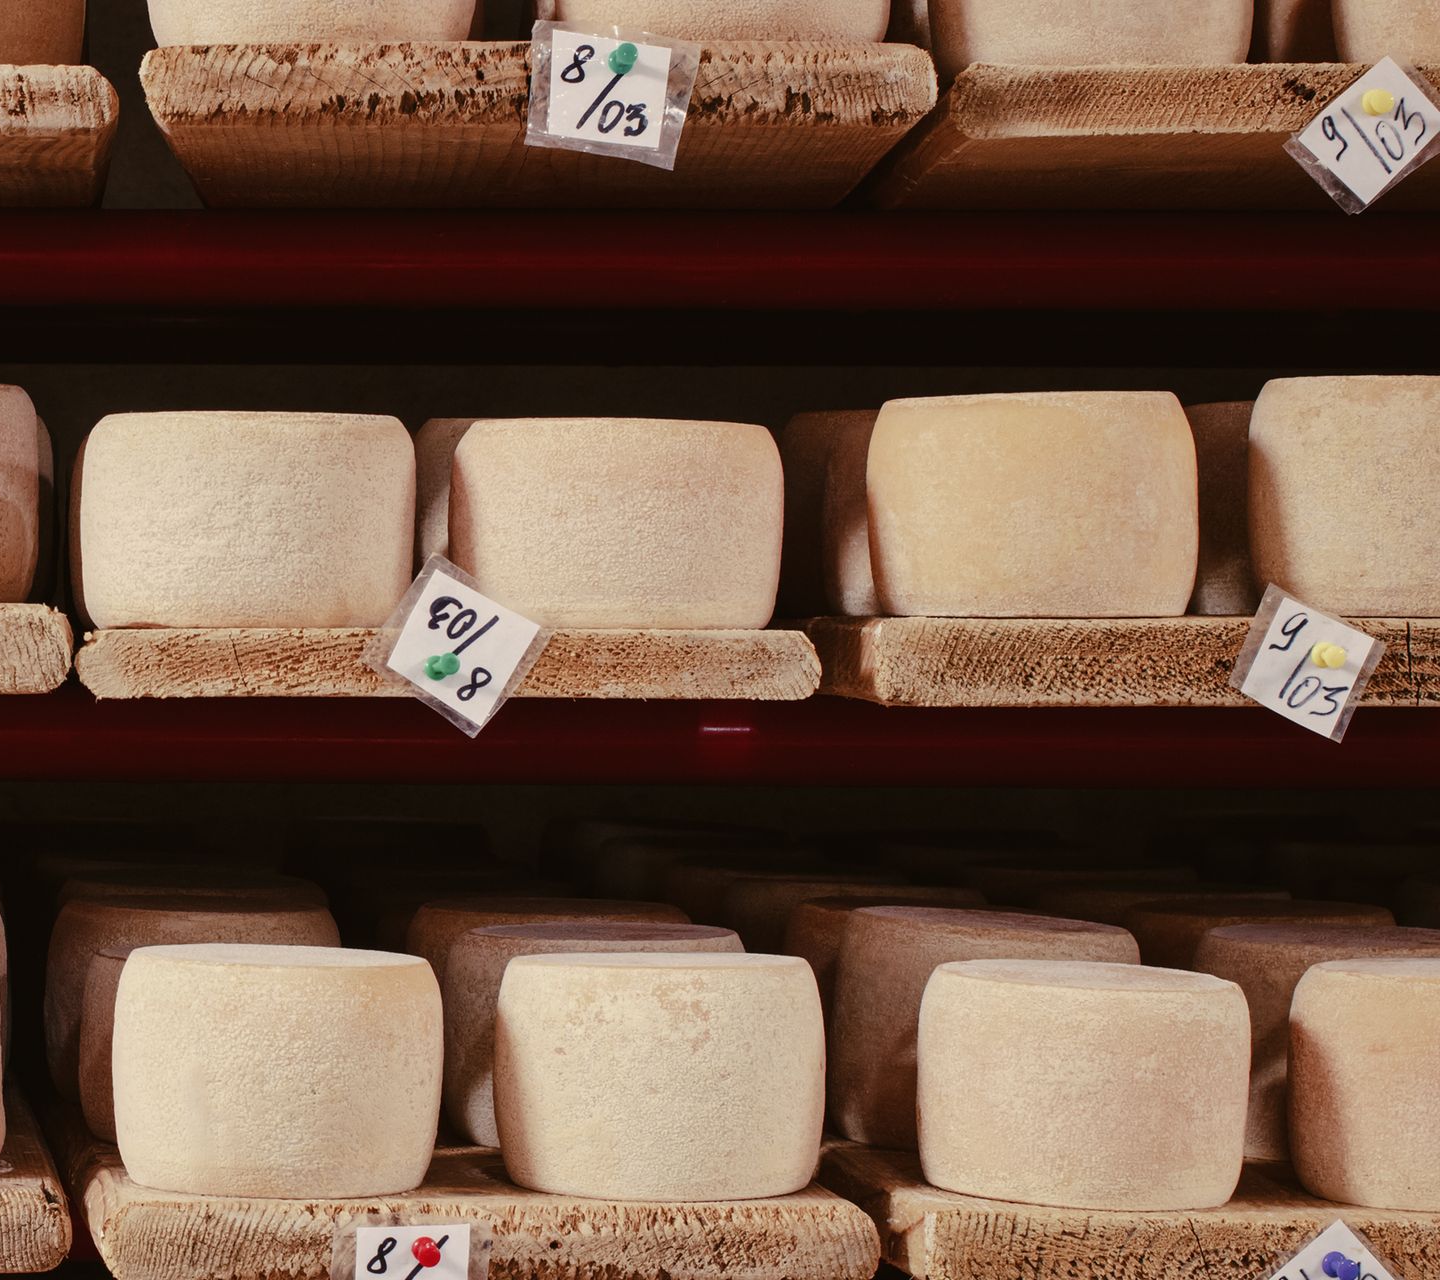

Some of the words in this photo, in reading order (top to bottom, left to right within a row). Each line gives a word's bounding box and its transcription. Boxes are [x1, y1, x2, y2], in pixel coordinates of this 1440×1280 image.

[560, 44, 649, 137] 8/03
[1321, 97, 1426, 175] 9/03
[427, 595, 500, 702] 8/03
[1268, 612, 1349, 716] 9/03
